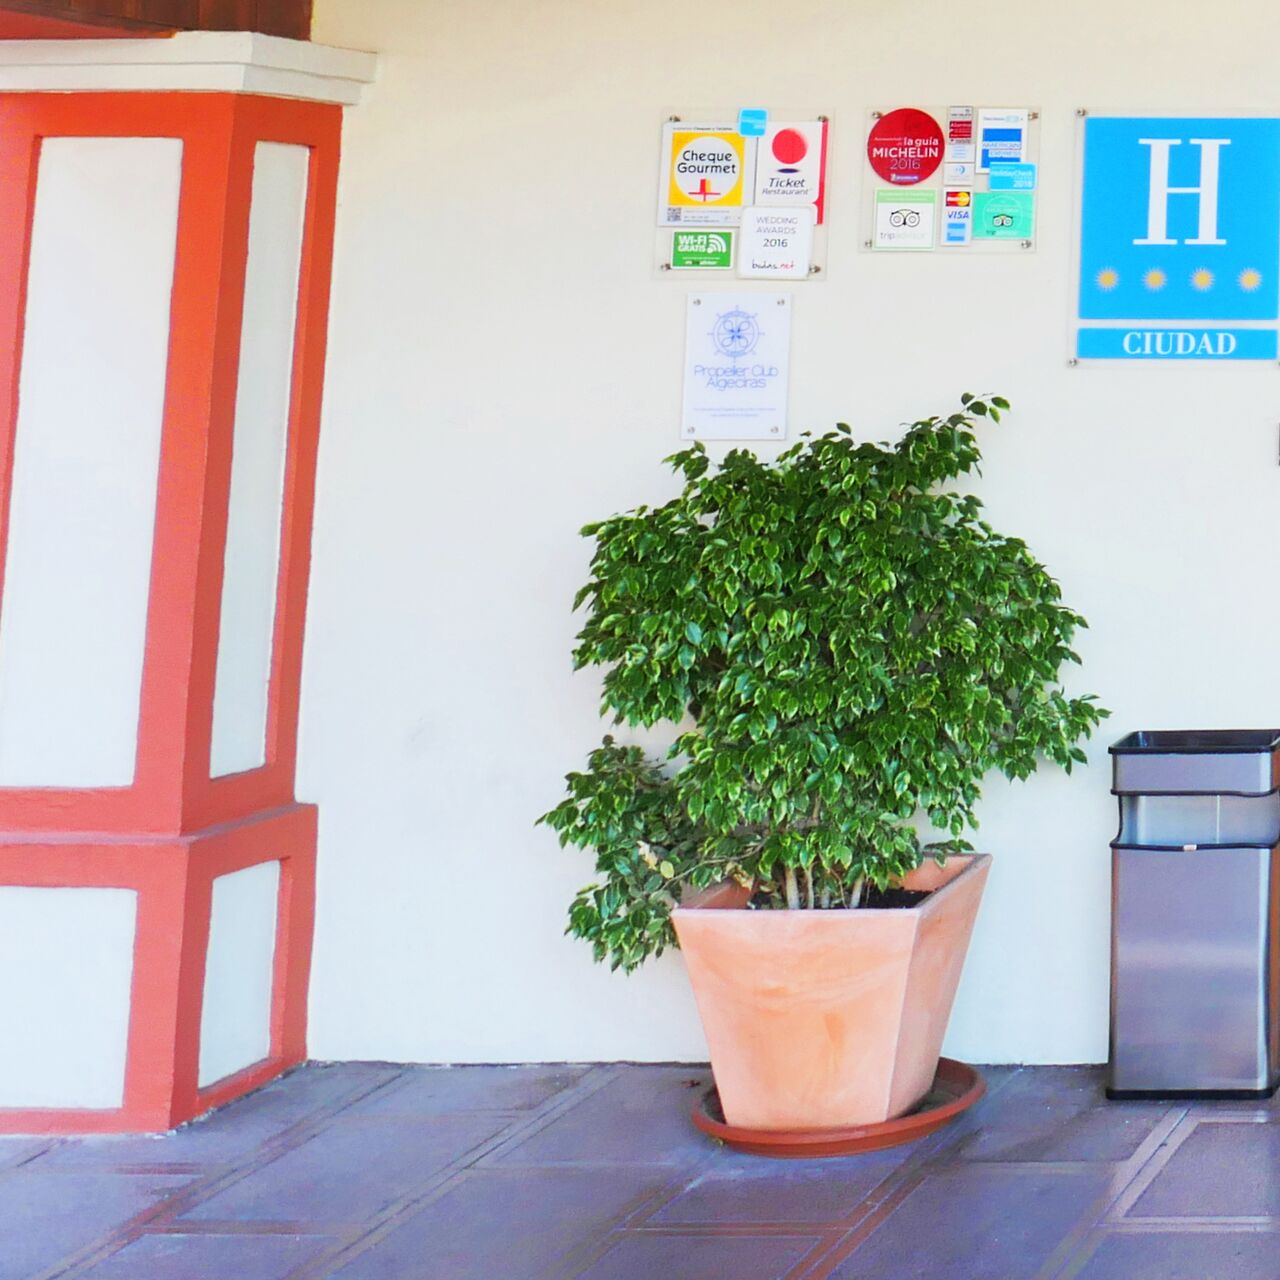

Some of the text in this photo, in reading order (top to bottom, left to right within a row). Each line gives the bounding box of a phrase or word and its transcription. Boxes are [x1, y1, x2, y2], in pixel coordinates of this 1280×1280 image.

[903, 137, 913, 146] la
[682, 150, 732, 163] Cheque
[872, 147, 939, 158] MICHELIN
[677, 162, 736, 174] Gourmet
[890, 158, 921, 170] 2016
[769, 177, 805, 188] Ticket
[1133, 138, 1231, 245] H
[756, 216, 798, 225] WEDDING
[947, 211, 969, 219] VISA
[678, 244, 706, 253] GRATIS
[763, 238, 788, 248] 2016
[1122, 331, 1237, 356] CIUDAD
